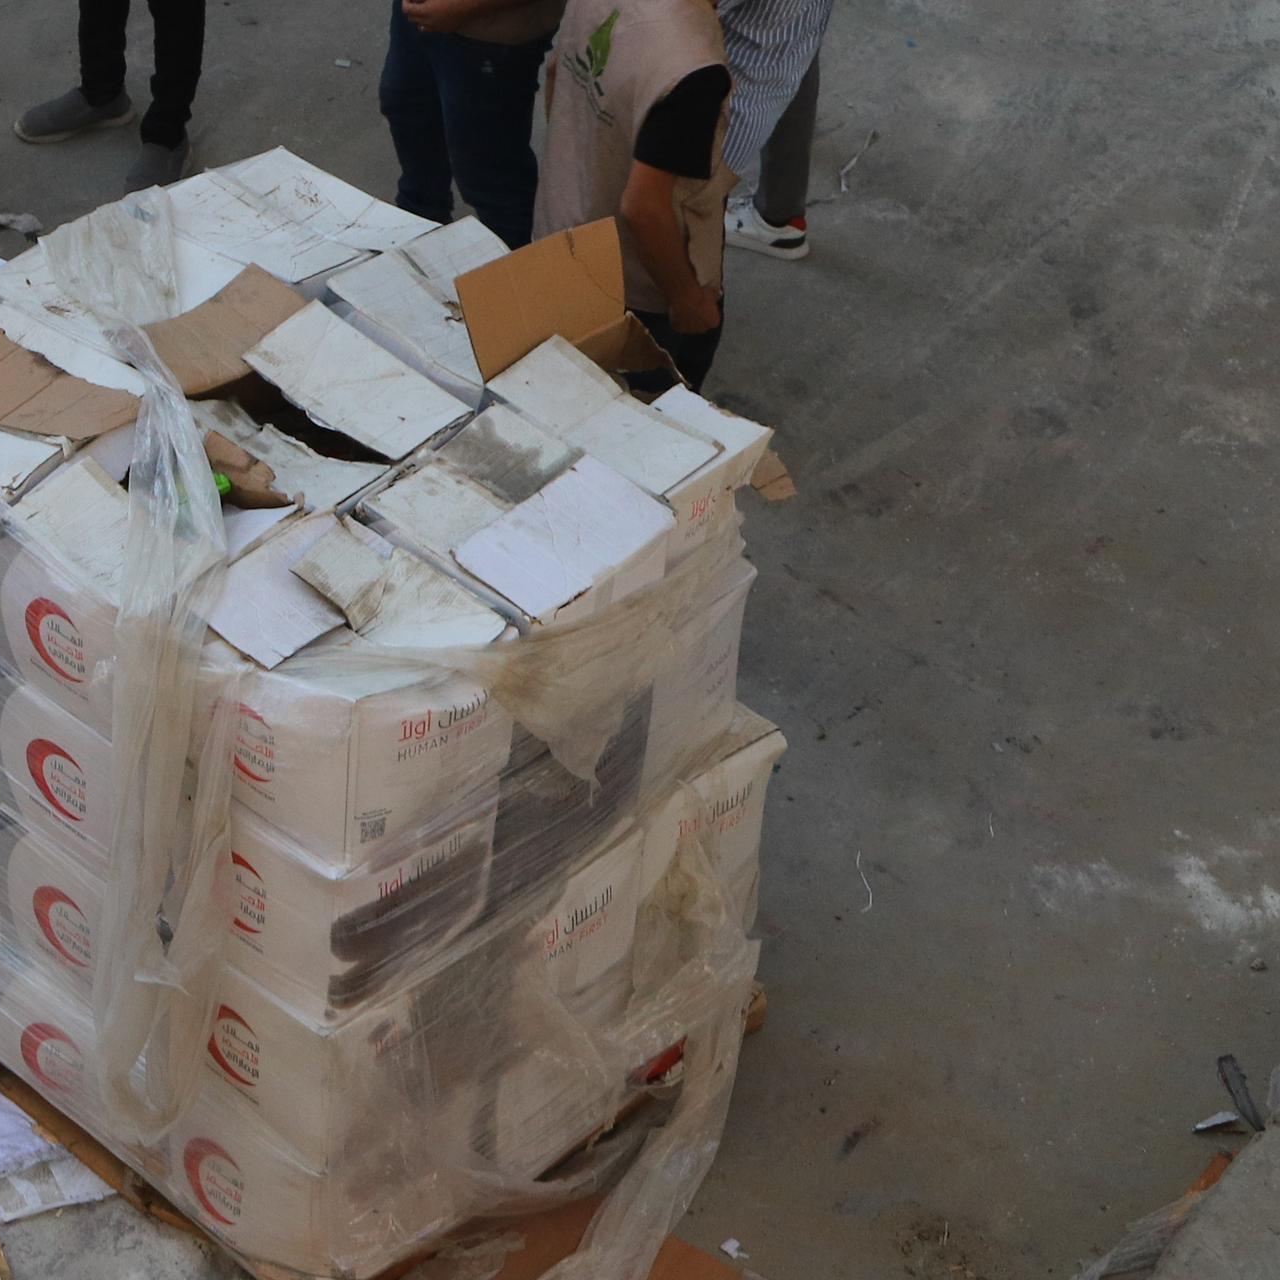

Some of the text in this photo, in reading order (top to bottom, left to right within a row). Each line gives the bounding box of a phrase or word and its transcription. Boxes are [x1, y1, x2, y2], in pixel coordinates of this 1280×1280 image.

[396, 711, 488, 763] HUMAN FIRST
[563, 885, 613, 936] الإنسان
[544, 911, 609, 964] MAN FIRST
